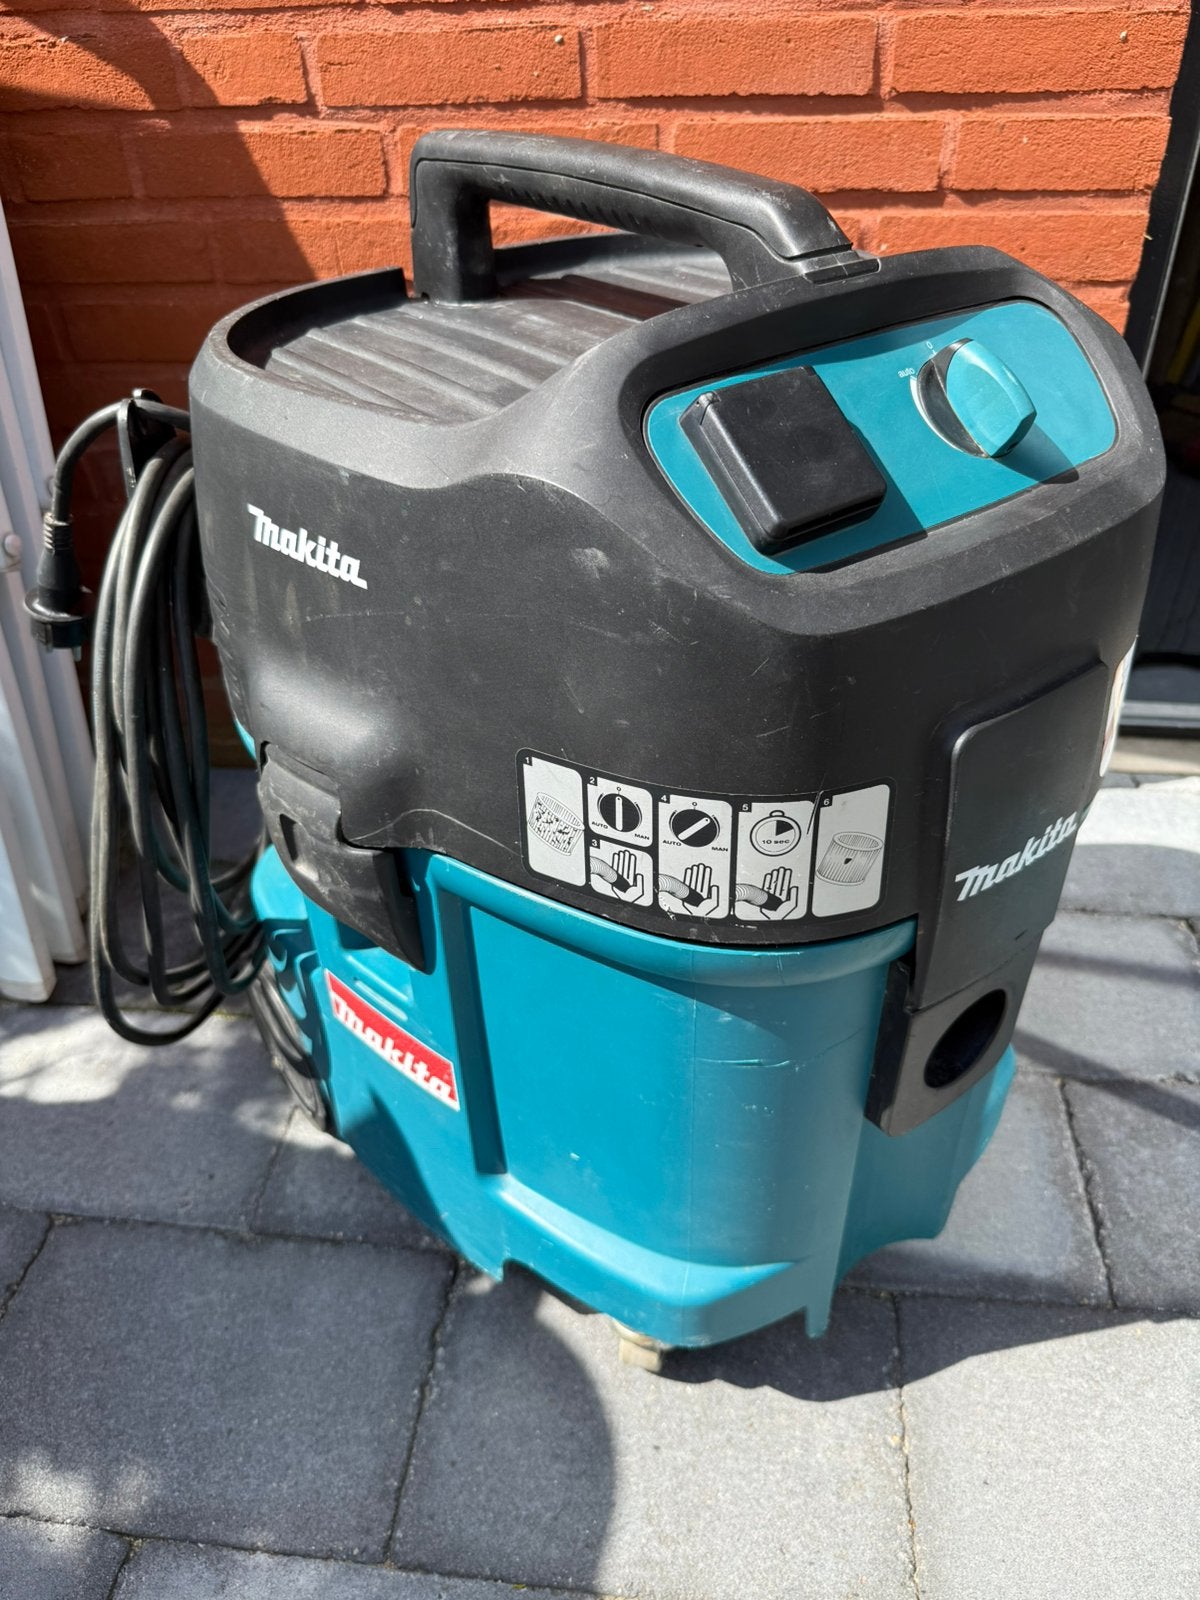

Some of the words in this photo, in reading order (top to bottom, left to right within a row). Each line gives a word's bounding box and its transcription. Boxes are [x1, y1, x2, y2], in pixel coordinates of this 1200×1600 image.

[898, 367, 915, 378] auto
[589, 776, 595, 784] 2
[660, 794, 668, 802] 4
[823, 798, 830, 806] 6
[742, 803, 749, 811] 5
[591, 820, 609, 830] AUTO
[634, 832, 650, 841] MAN
[591, 839, 598, 847] 3
[662, 839, 682, 847] AUTO
